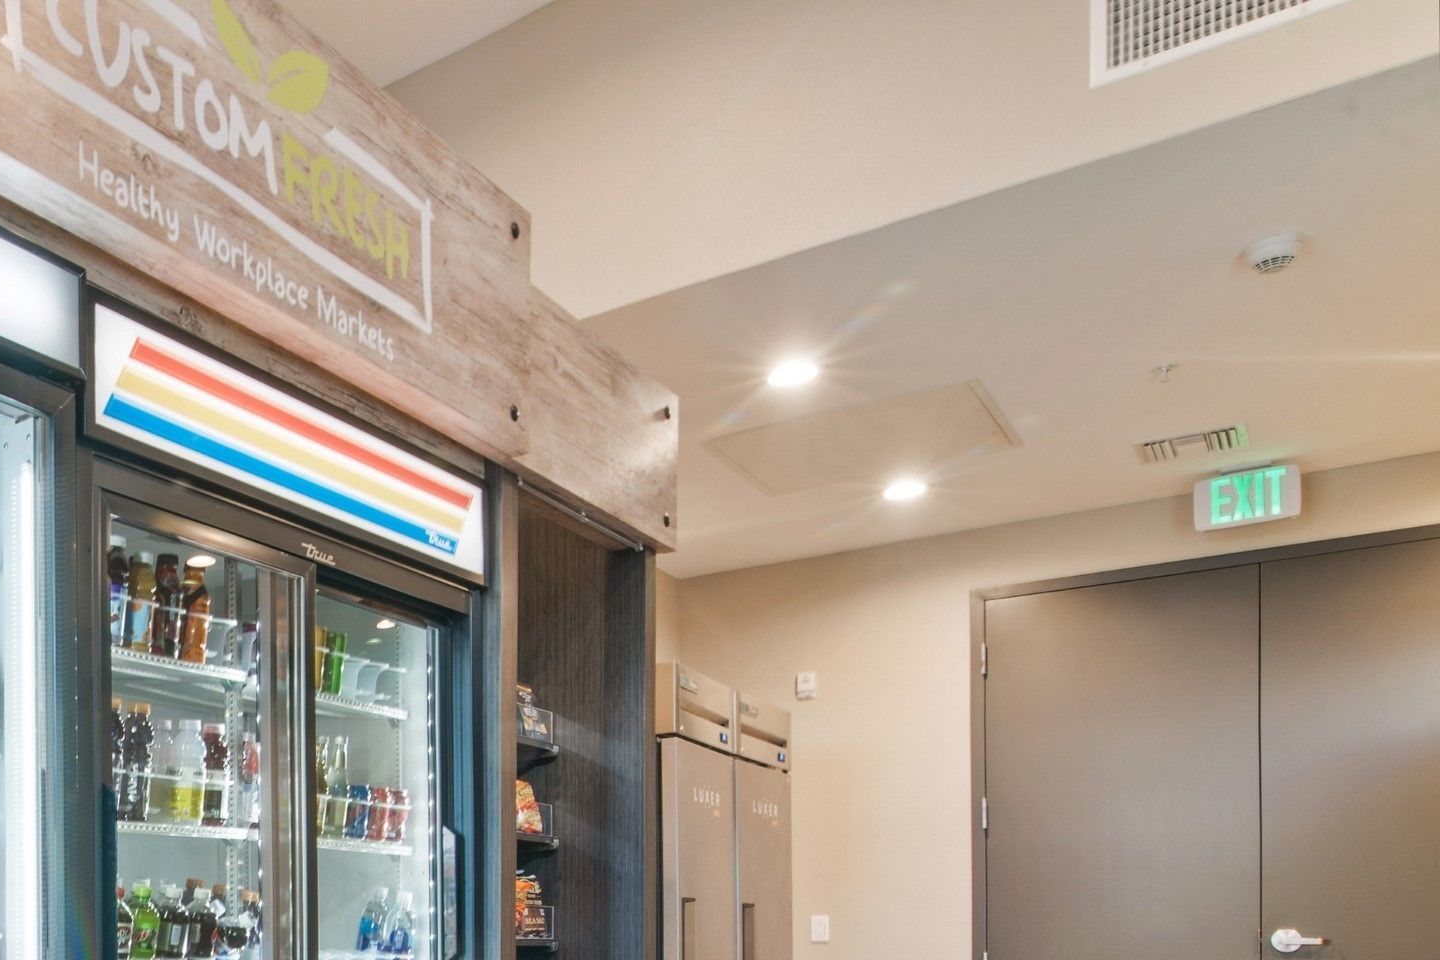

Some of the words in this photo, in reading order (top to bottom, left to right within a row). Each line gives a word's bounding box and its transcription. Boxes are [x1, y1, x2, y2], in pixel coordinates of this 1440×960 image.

[78, 138, 180, 243] Healthy
[194, 213, 309, 310] Workplace
[316, 285, 394, 362] Markets
[283, 128, 411, 282] FRESH
[1209, 466, 1288, 526] EXIT
